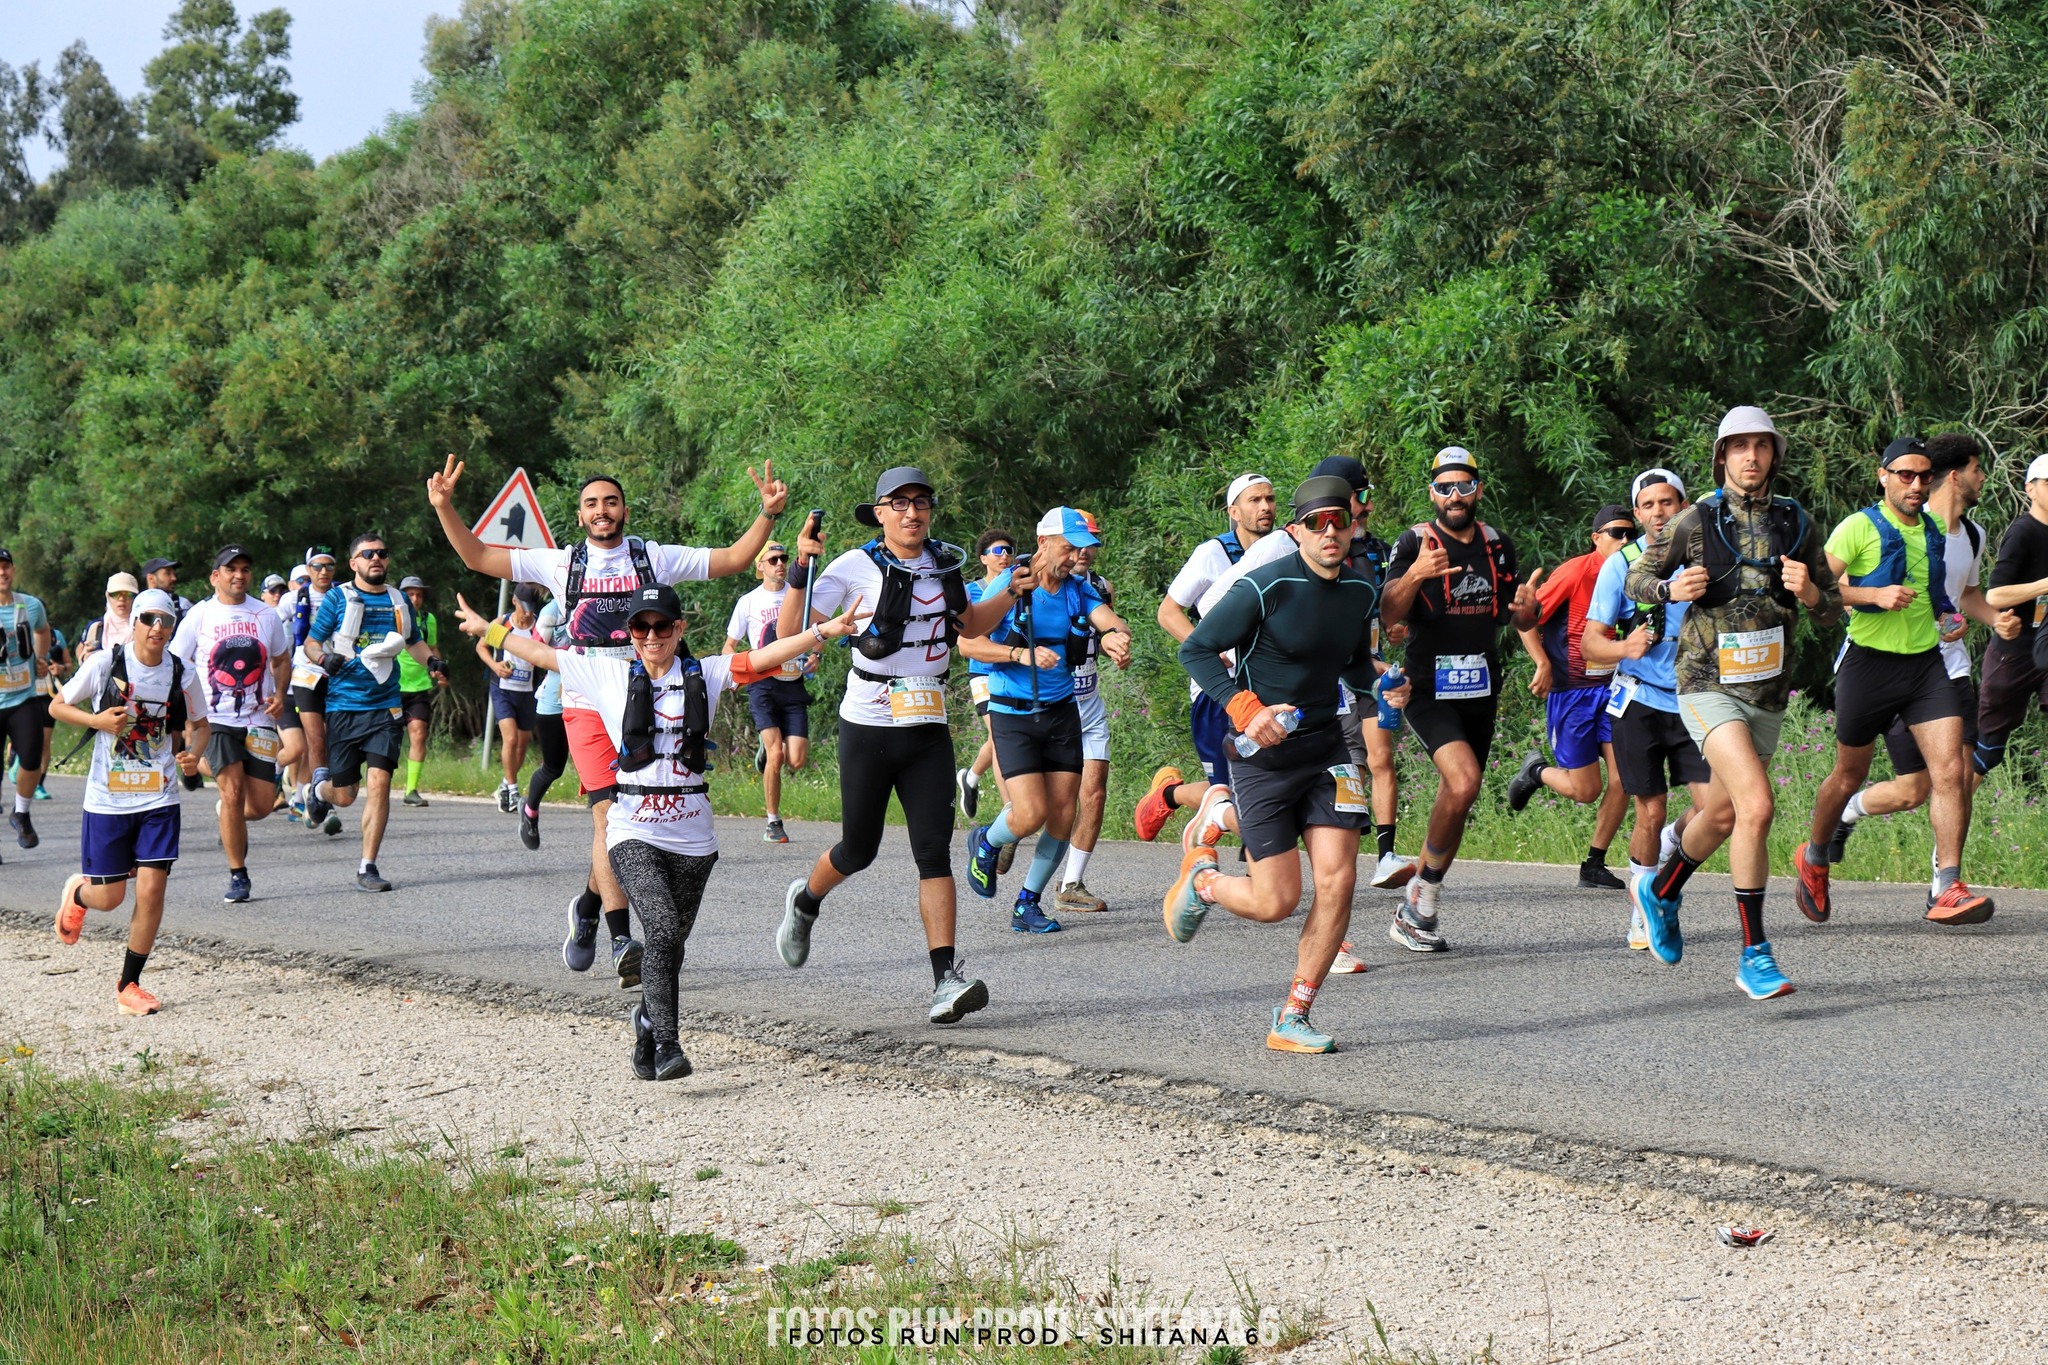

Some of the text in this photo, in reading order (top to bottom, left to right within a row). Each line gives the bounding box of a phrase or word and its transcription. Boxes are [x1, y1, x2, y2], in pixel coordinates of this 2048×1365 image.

[214, 621, 259, 642] SHITANA
[225, 635, 253, 649] 2025
[1733, 646, 1770, 665] 457
[1448, 669, 1481, 684] 629
[902, 692, 935, 708] 351
[251, 737, 273, 750] 342
[119, 772, 150, 785] 497
[1346, 779, 1365, 797] 43
[630, 813, 660, 824] RUN
[669, 808, 702, 823] SFAX
